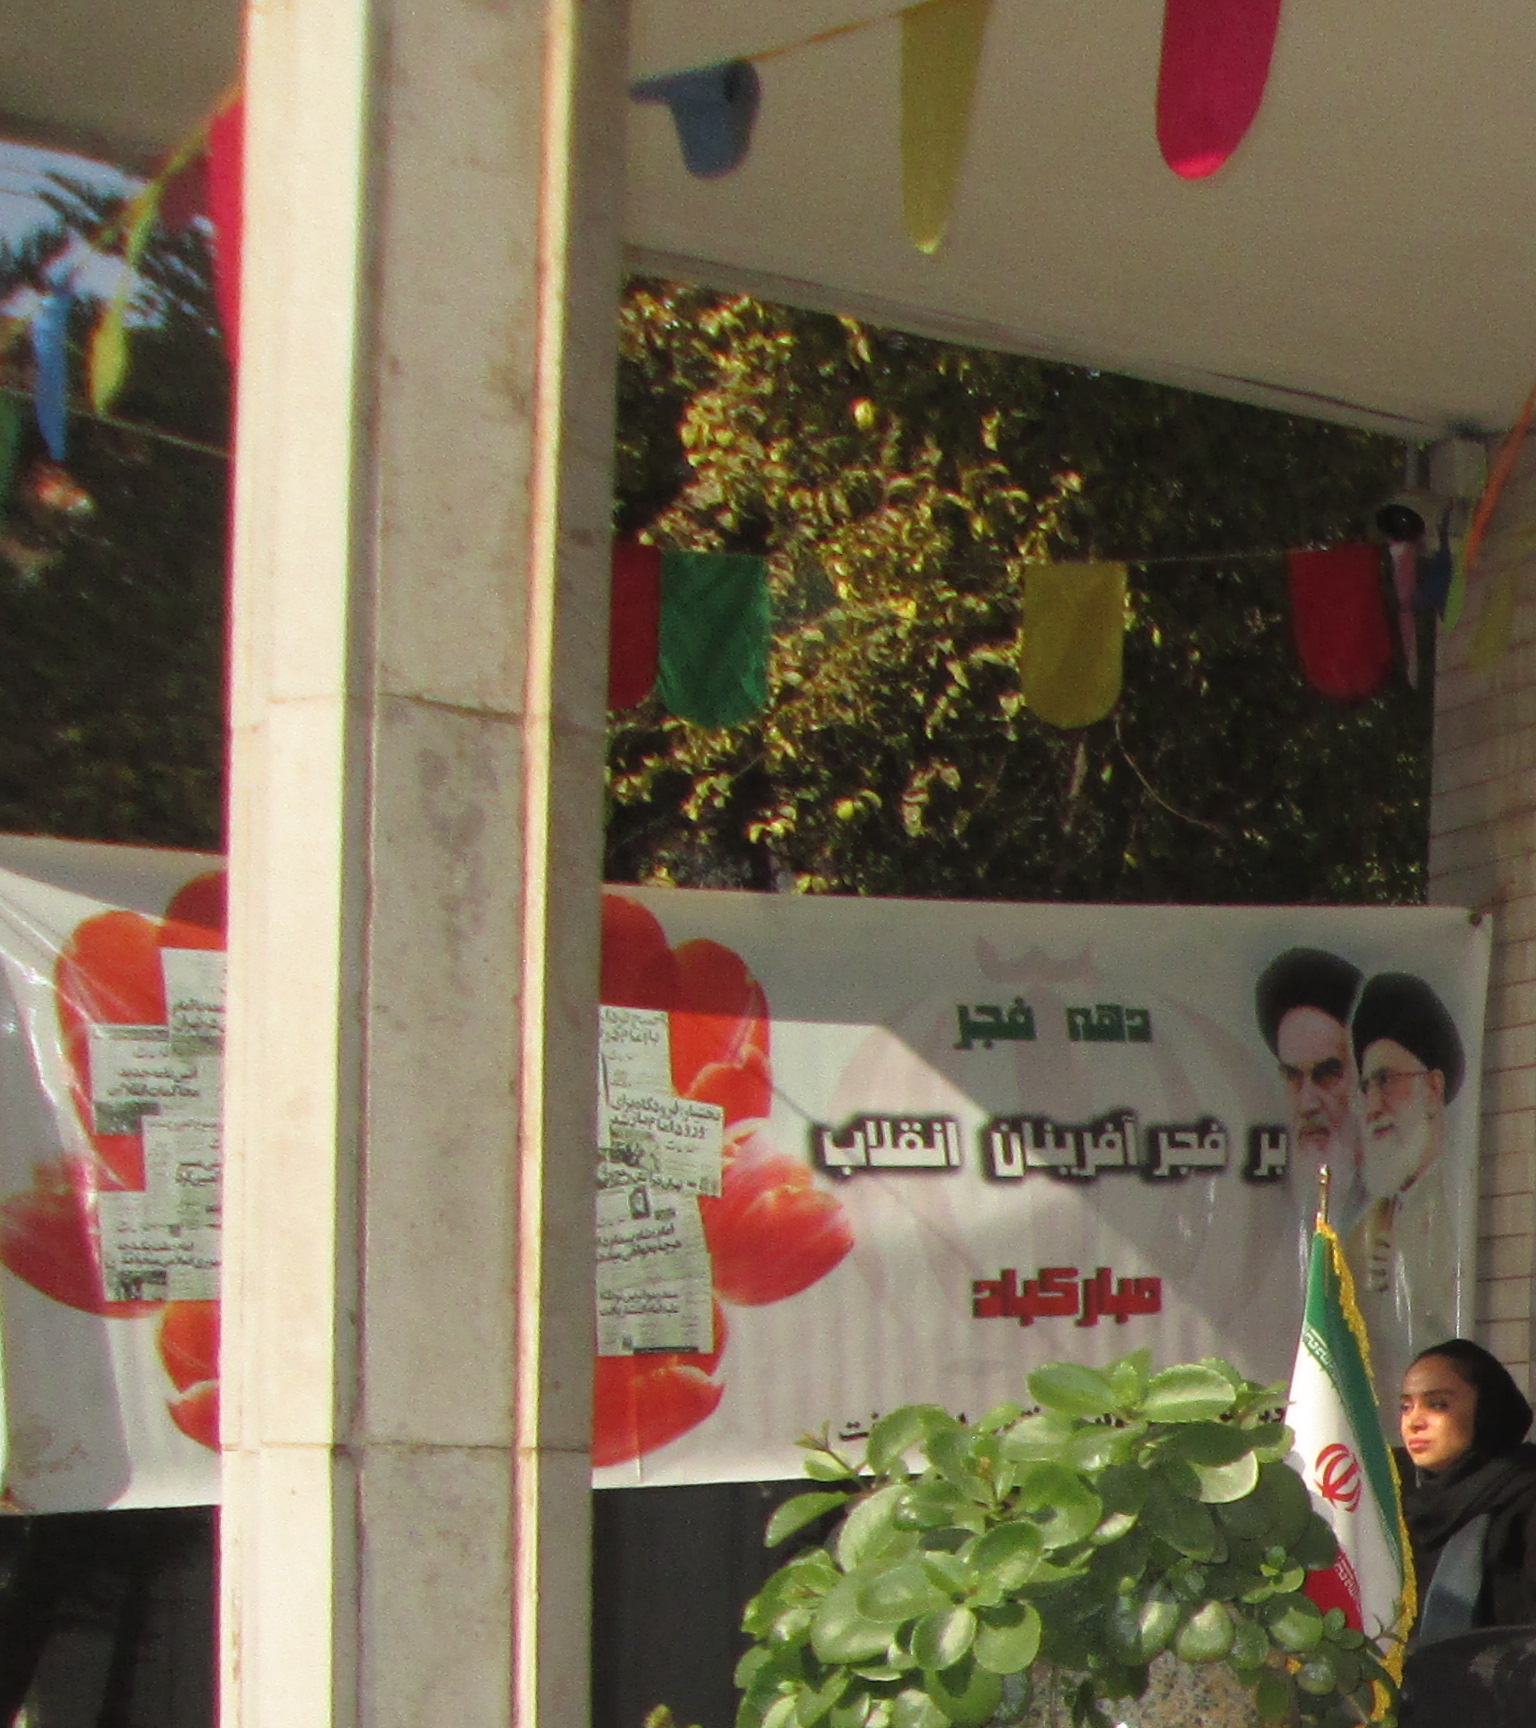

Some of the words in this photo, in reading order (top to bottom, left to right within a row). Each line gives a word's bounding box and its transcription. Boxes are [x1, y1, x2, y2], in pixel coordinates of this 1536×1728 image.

[953, 997, 1036, 1050] فجر
[822, 1119, 961, 1178] انقلاب
[1152, 1118, 1228, 1178] فجر
[972, 1267, 1162, 1328] مبارکباد
